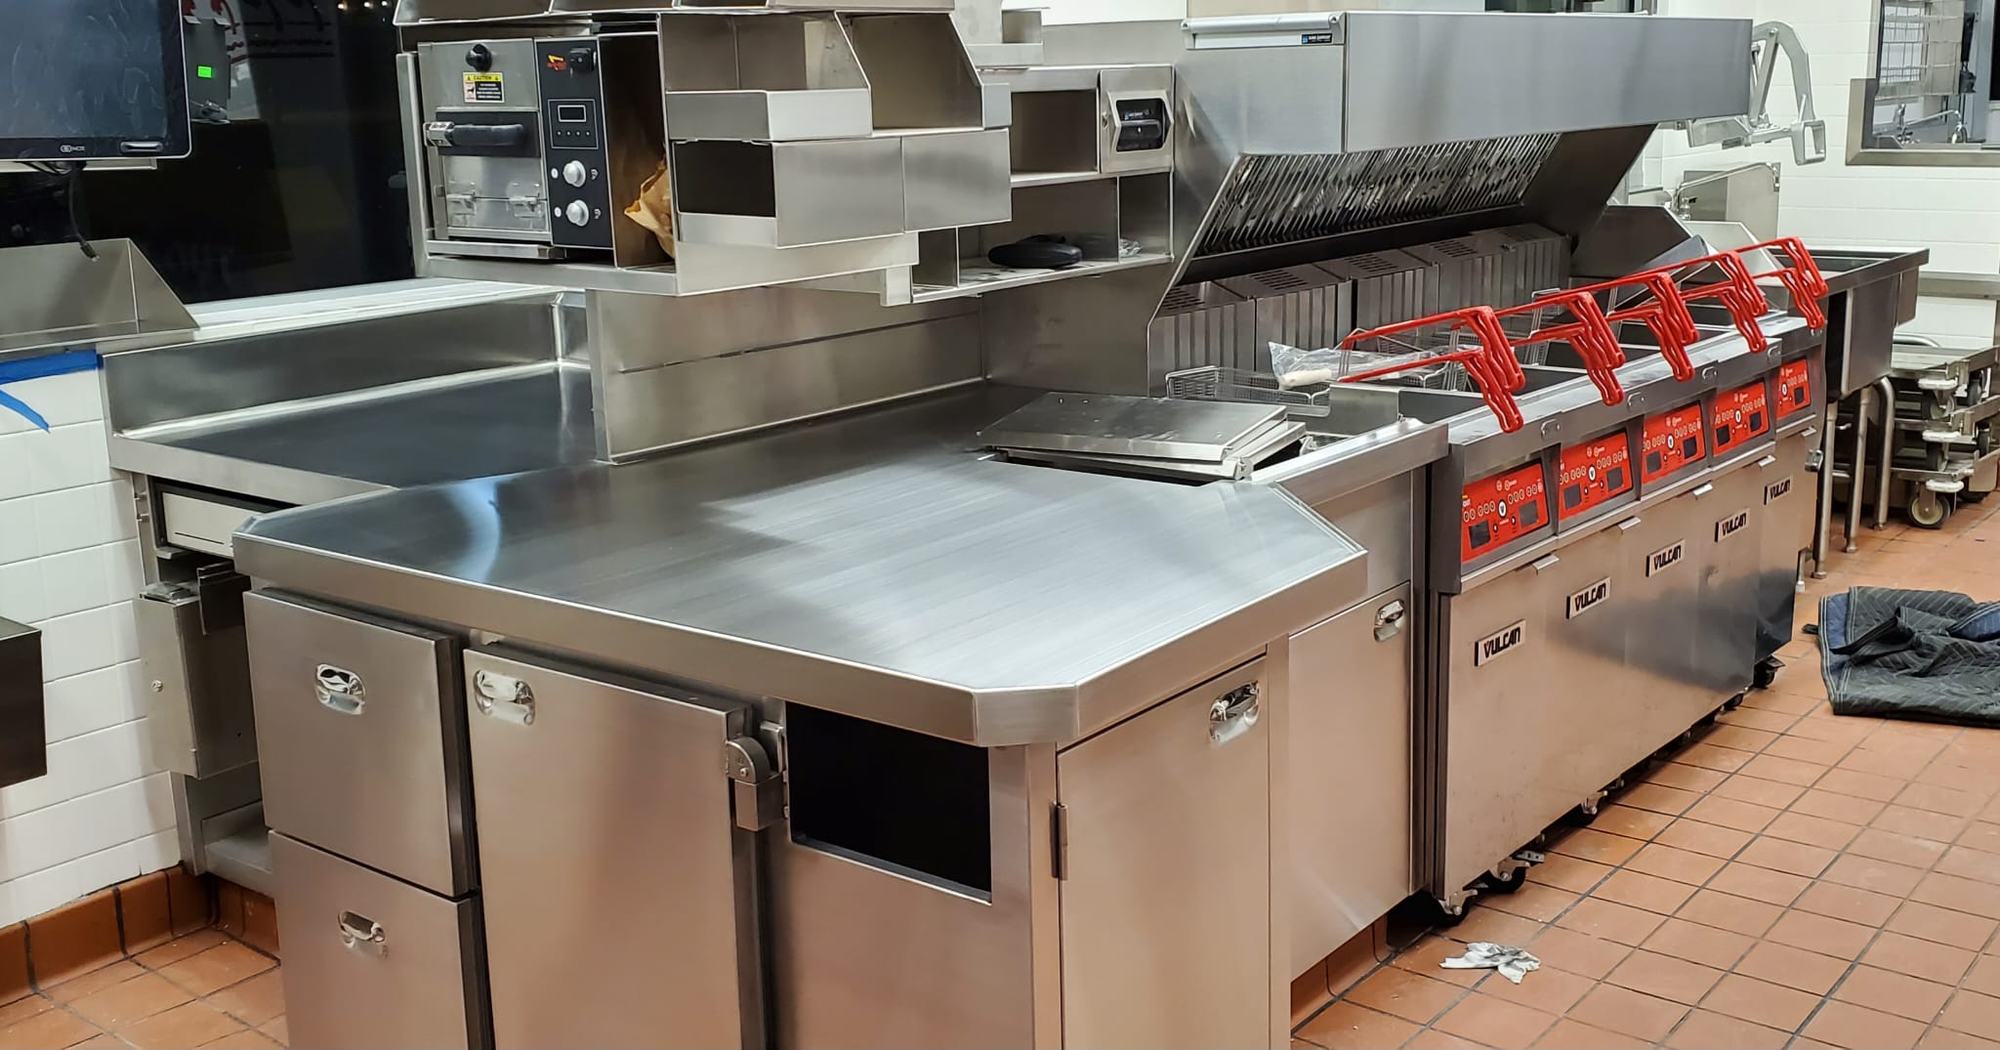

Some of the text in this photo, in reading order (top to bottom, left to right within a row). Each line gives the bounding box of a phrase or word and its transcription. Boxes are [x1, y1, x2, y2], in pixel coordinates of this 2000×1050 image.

[1769, 479, 1791, 500] VULCAN
[1721, 512, 1747, 536] VULCAN
[1653, 544, 1682, 571] VULCAN
[1574, 582, 1606, 612] VULCAN
[1483, 626, 1521, 659] VULCAN
